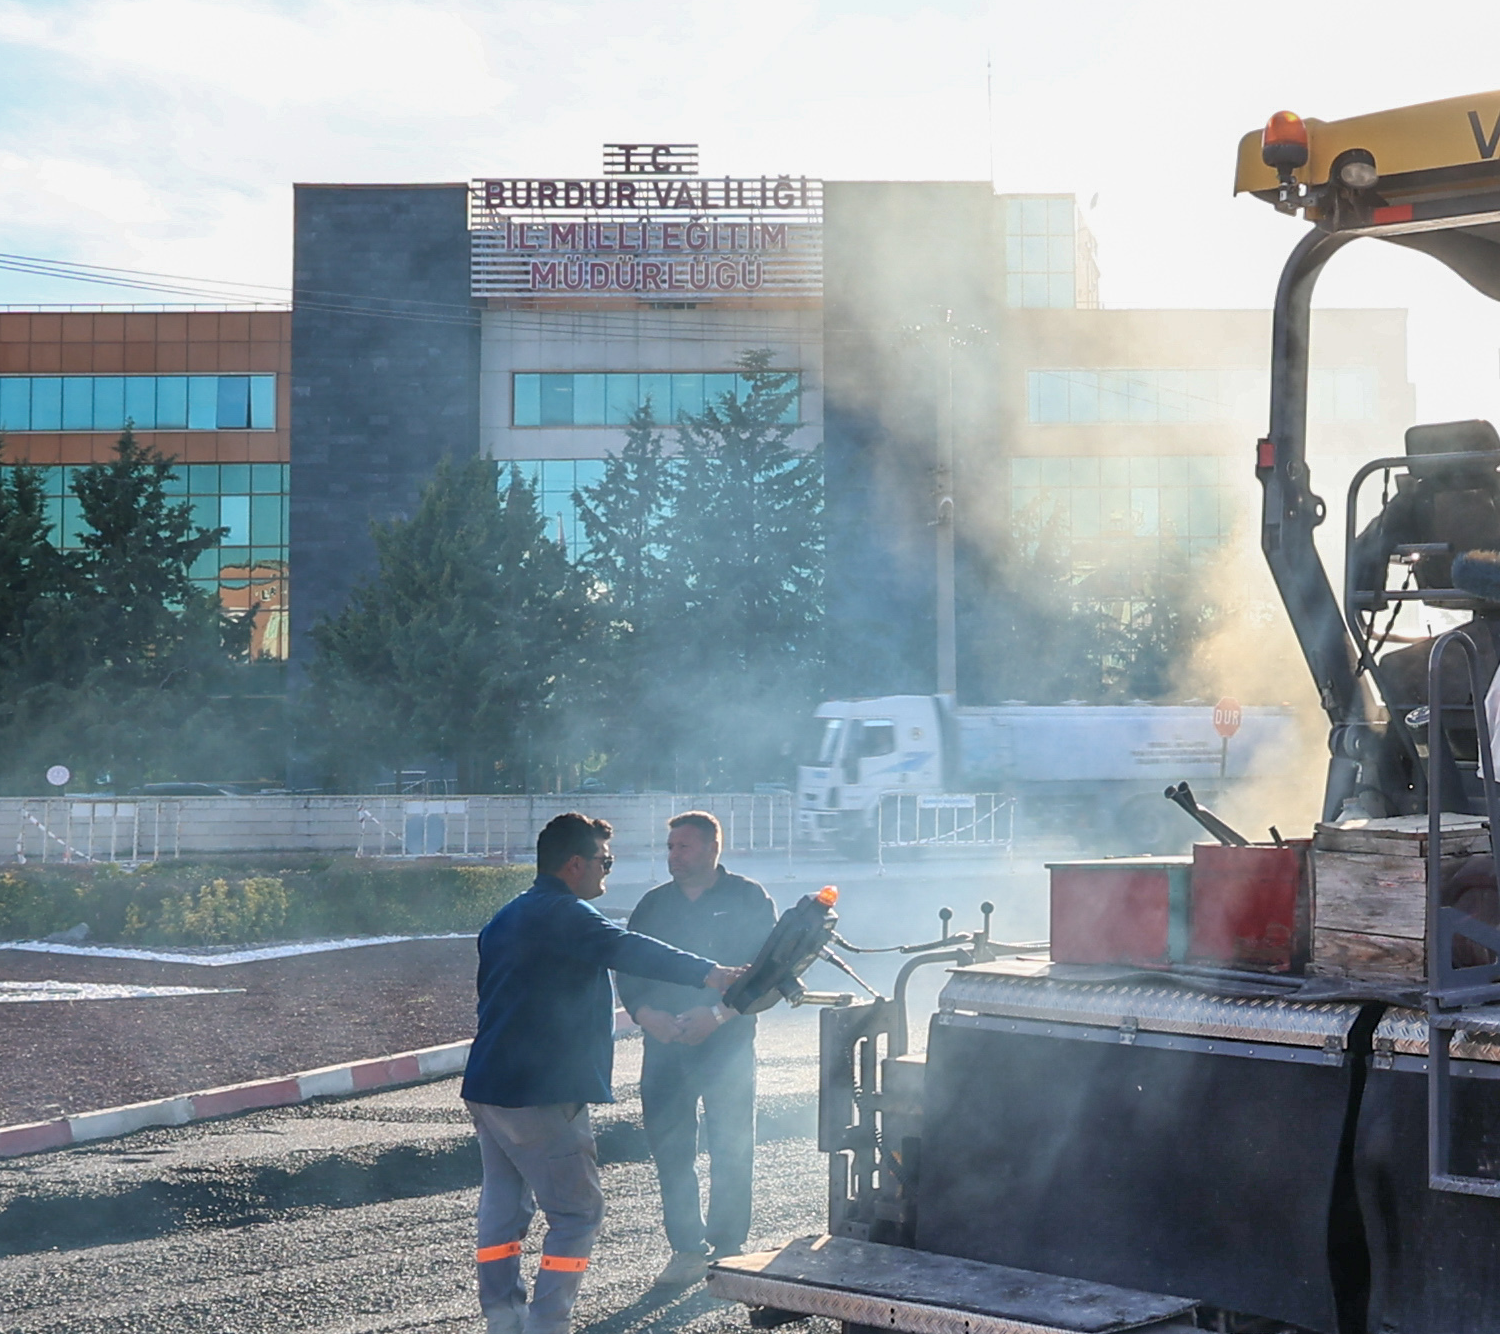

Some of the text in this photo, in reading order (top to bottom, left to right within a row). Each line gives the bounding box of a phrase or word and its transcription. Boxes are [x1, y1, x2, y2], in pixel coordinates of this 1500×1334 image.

[618, 144, 683, 173] T.C.
[485, 175, 810, 209] BURDUR VALİLİĞİ
[661, 215, 789, 251] EĞİTİM
[529, 255, 764, 291] MÜDÜRLÜĞÜ
[1215, 709, 1239, 725] DUR
